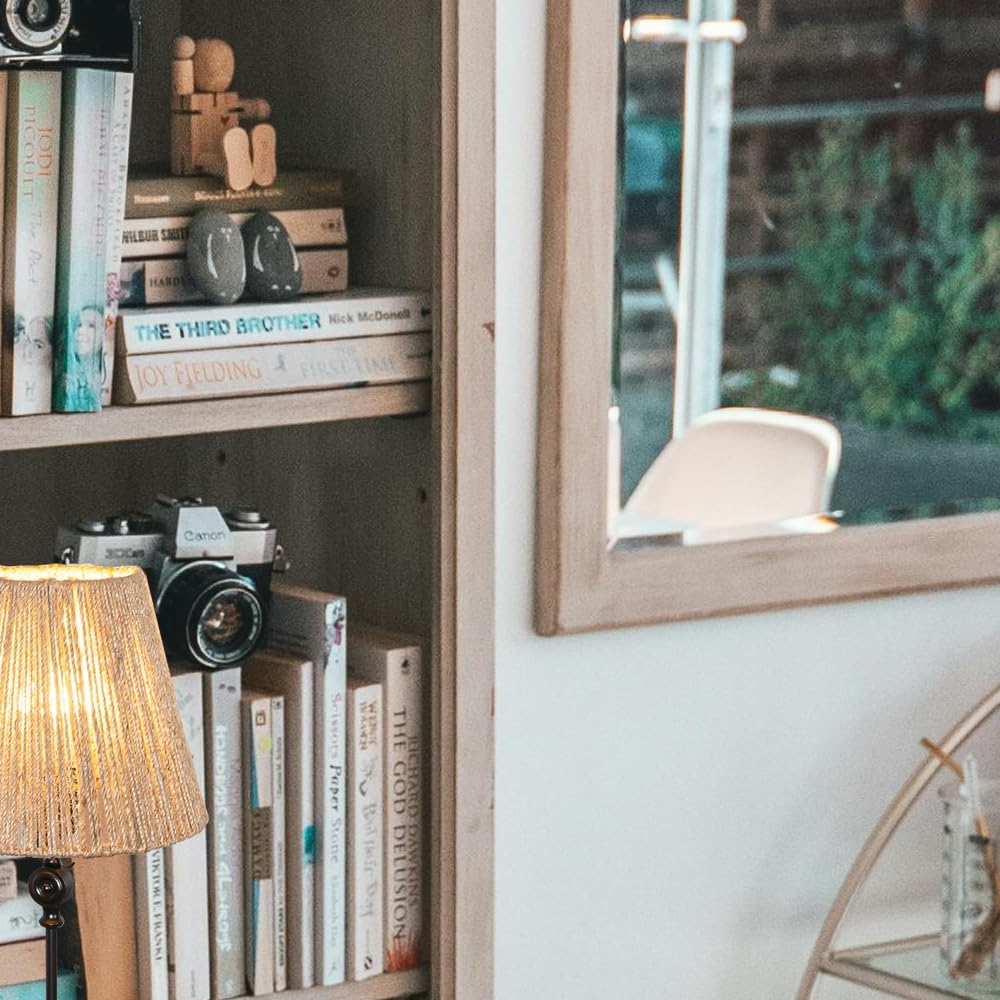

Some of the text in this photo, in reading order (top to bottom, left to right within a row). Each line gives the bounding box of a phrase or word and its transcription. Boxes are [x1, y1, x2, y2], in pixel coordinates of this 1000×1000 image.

[23, 105, 37, 200] PICOULT
[37, 127, 55, 177] JODI
[135, 312, 322, 342] THE THIRD BROTHER
[328, 312, 355, 325] Nick
[134, 358, 264, 390] JOY FIELDING
[183, 529, 226, 543] Canon
[329, 764, 343, 813] Paper
[393, 705, 408, 940] THE GOD DELUSION
[151, 849, 162, 898] VIKTOR
